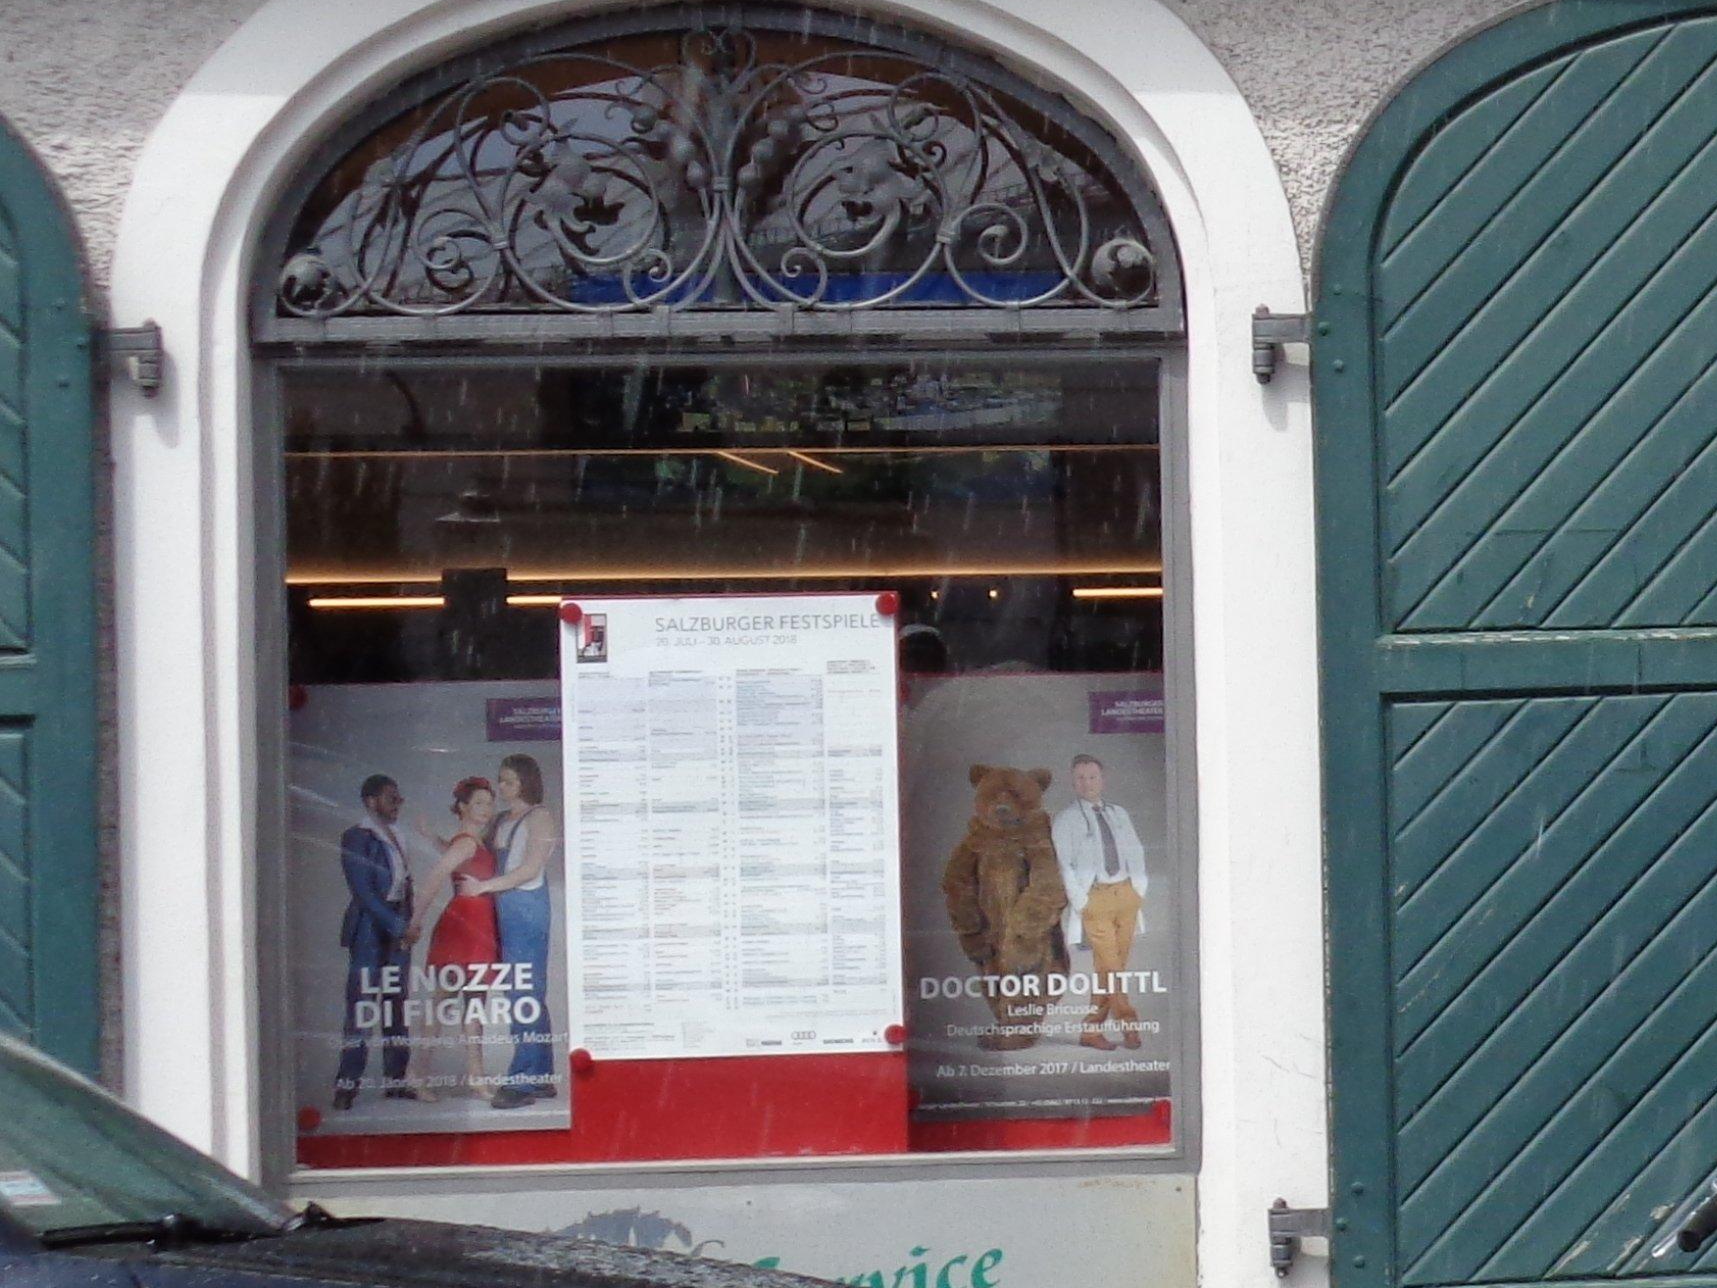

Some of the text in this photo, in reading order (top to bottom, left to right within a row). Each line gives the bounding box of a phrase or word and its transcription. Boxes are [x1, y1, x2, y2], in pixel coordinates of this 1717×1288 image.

[655, 614, 880, 632] SALZBURGER FESTSPIELE
[360, 962, 534, 994] LE NOZZE
[920, 971, 1168, 999] DOCTOR DOLITTL
[355, 996, 542, 1029] DI FIGARO
[1007, 1002, 1098, 1017] Leslie Bricusse
[946, 1022, 1062, 1039] Deutschsprachige
[936, 1065, 955, 1078] Ab
[970, 1063, 1037, 1077] Dezember
[1039, 1062, 1069, 1074] 2017
[1079, 1059, 1171, 1074] Landestheater
[469, 1072, 562, 1086] Landestheater
